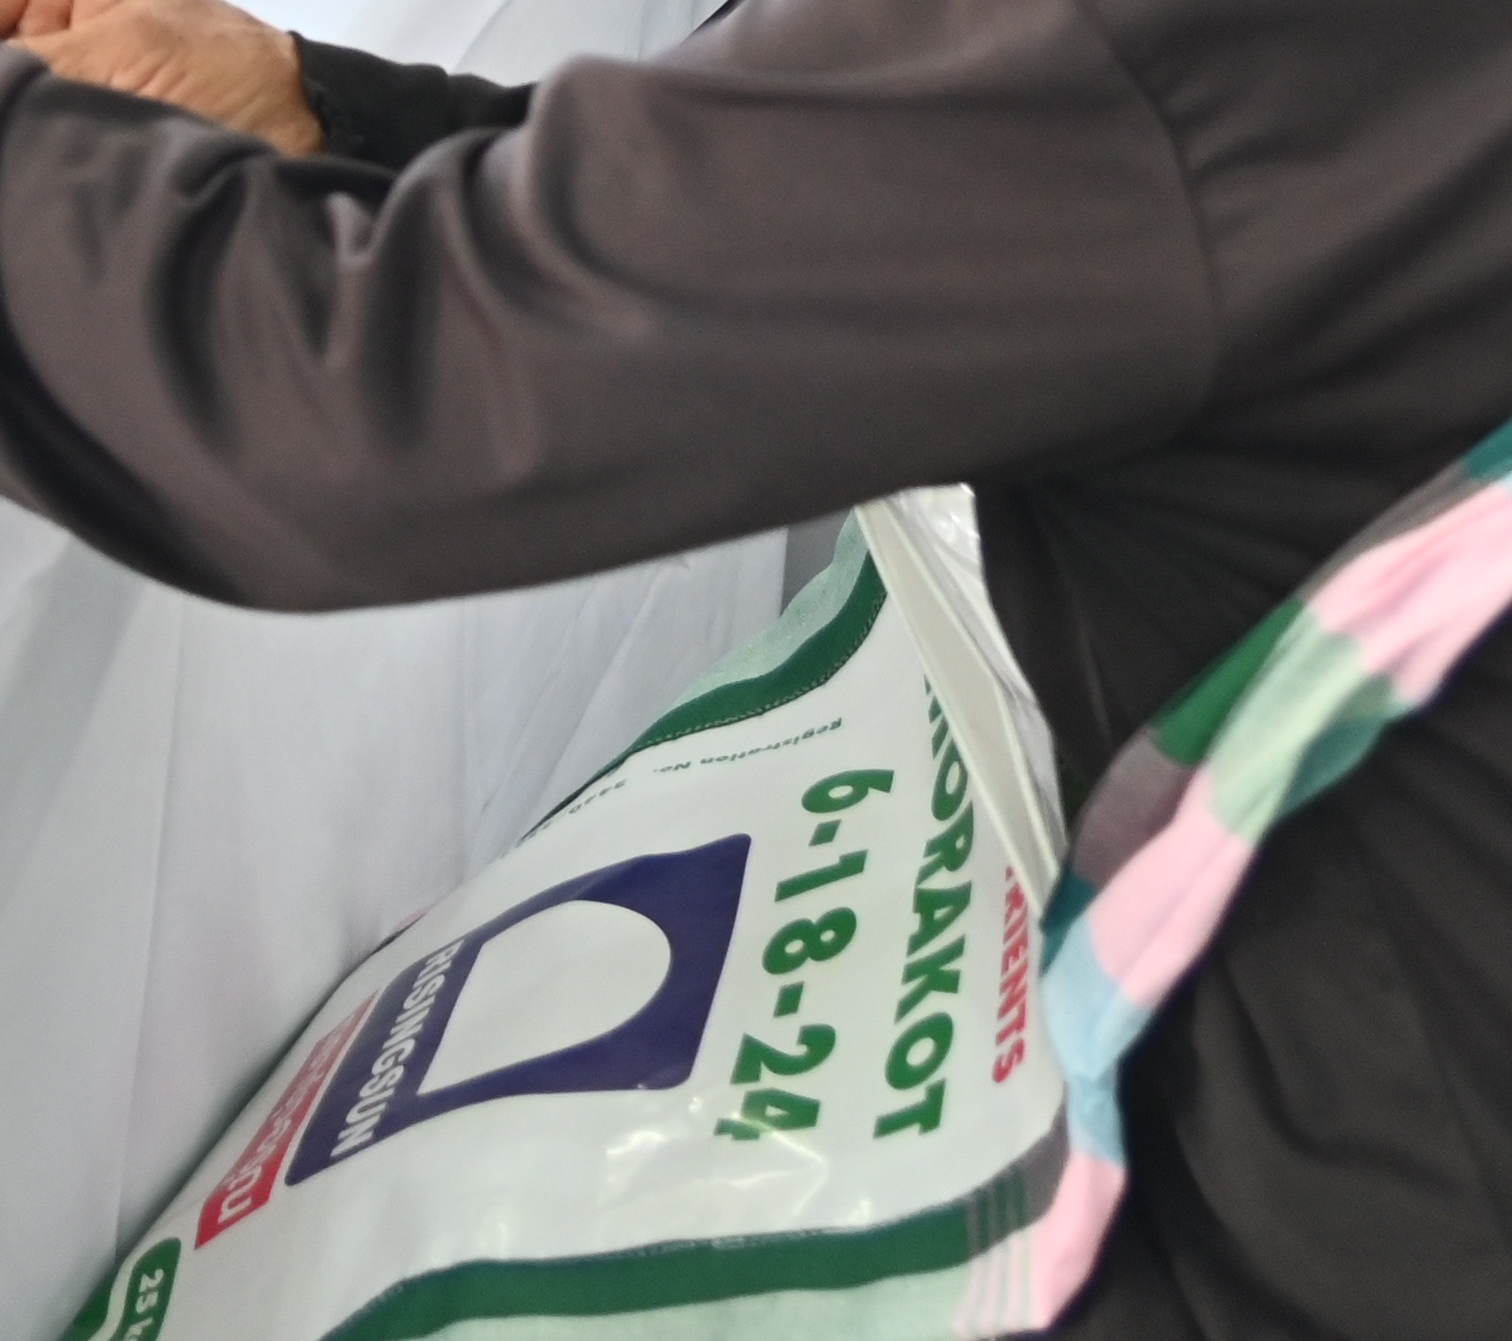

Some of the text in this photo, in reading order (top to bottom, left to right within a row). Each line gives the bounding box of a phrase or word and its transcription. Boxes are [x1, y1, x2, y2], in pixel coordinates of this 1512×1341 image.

[699, 717, 843, 766] Registration
[329, 938, 465, 1158] RISINGSUN
[713, 768, 895, 1142] 6-18-24
[992, 866, 1029, 1085] RIENTS
